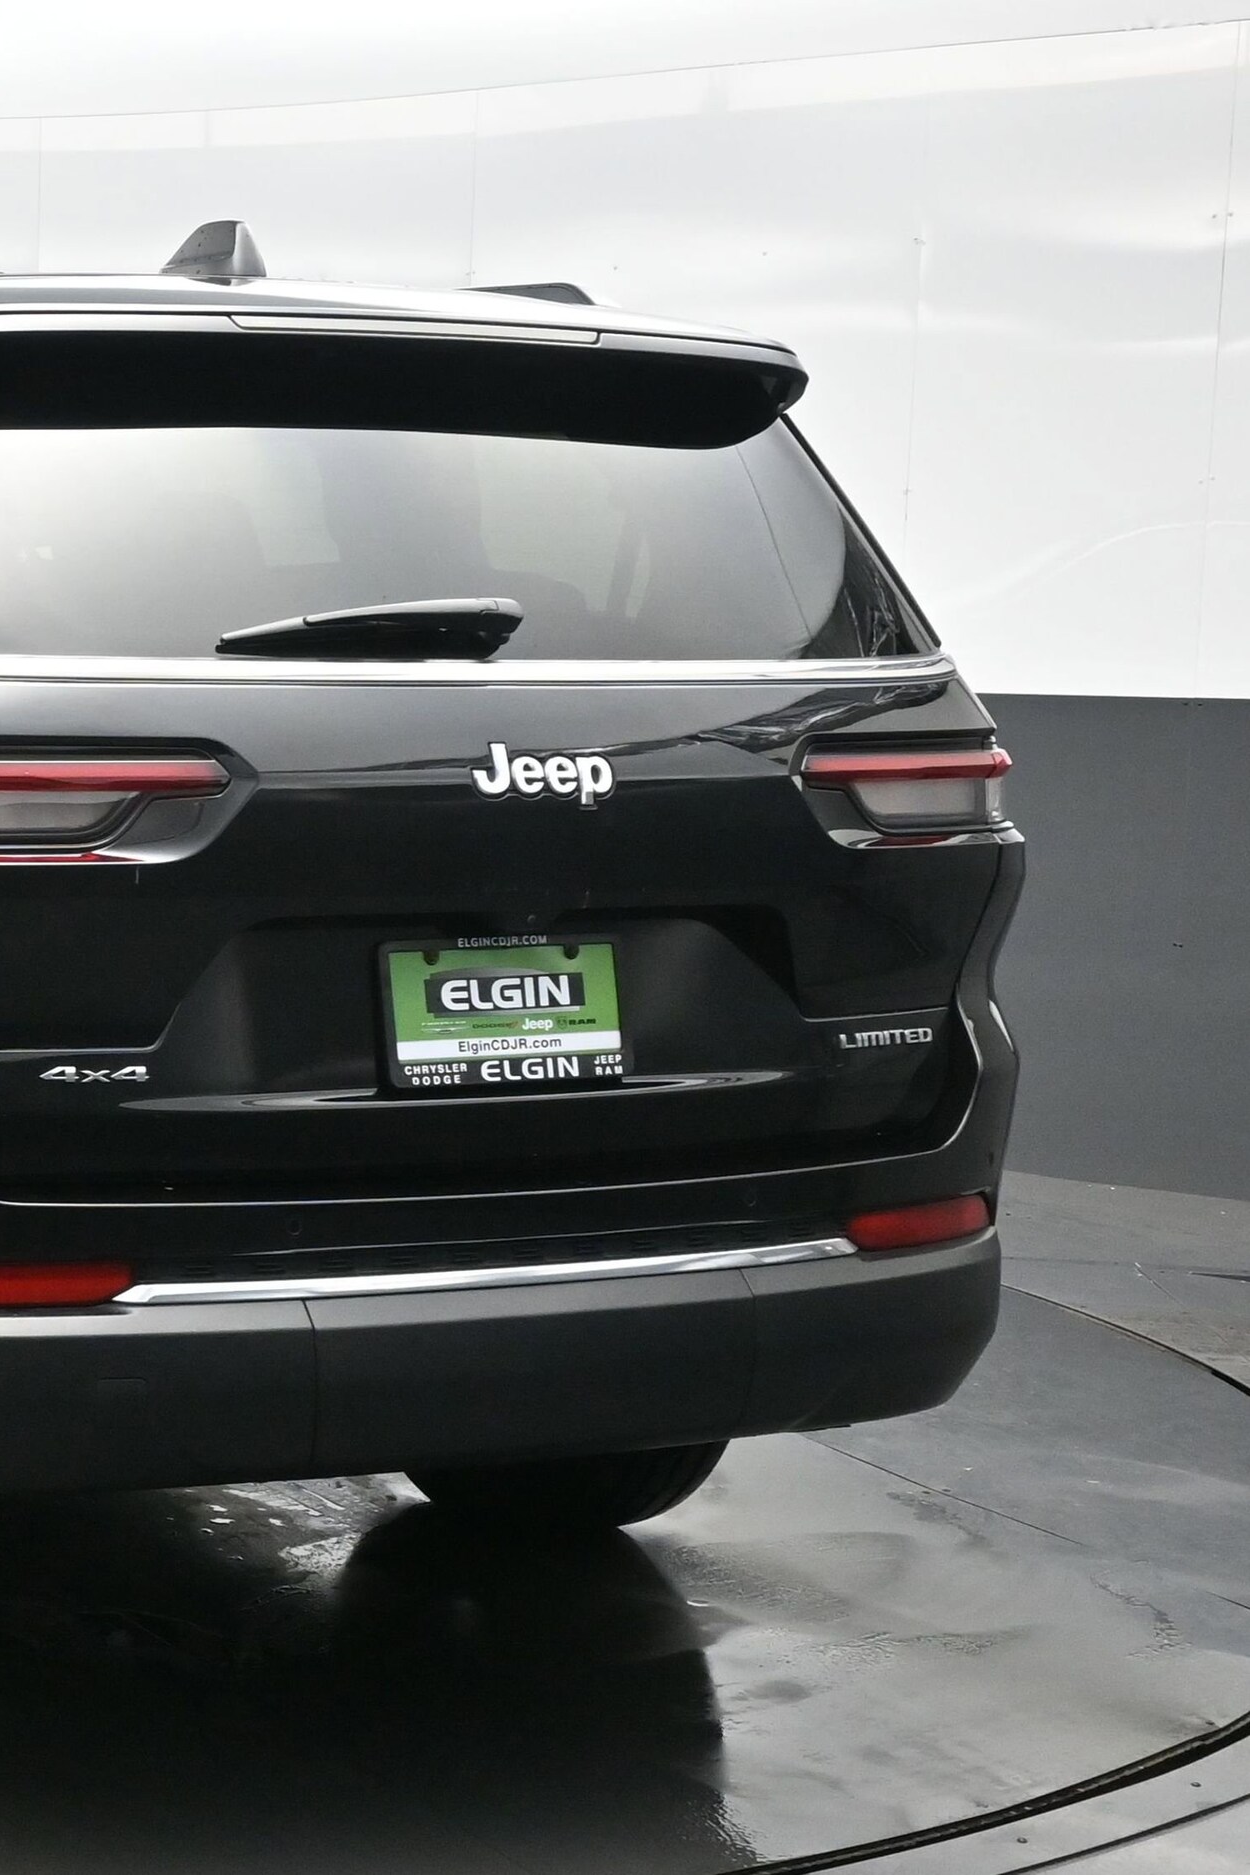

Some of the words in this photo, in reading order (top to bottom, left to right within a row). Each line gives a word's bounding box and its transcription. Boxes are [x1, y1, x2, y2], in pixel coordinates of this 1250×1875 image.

[471, 742, 614, 805] Jeep
[457, 935, 548, 948] ELGINCDJR.COM
[440, 974, 572, 1011] ELGIN
[521, 1017, 553, 1032] Jeep
[568, 1018, 597, 1026] RAM
[458, 1037, 562, 1055] ElginCDJR.com
[838, 1027, 933, 1049] LIMITED
[593, 1054, 623, 1065] JEEP
[38, 1065, 151, 1083] 4x4
[404, 1062, 468, 1076] CHRYSLER
[480, 1056, 580, 1082] ELGIN
[595, 1064, 623, 1075] RAM
[411, 1074, 462, 1086] DODGE
